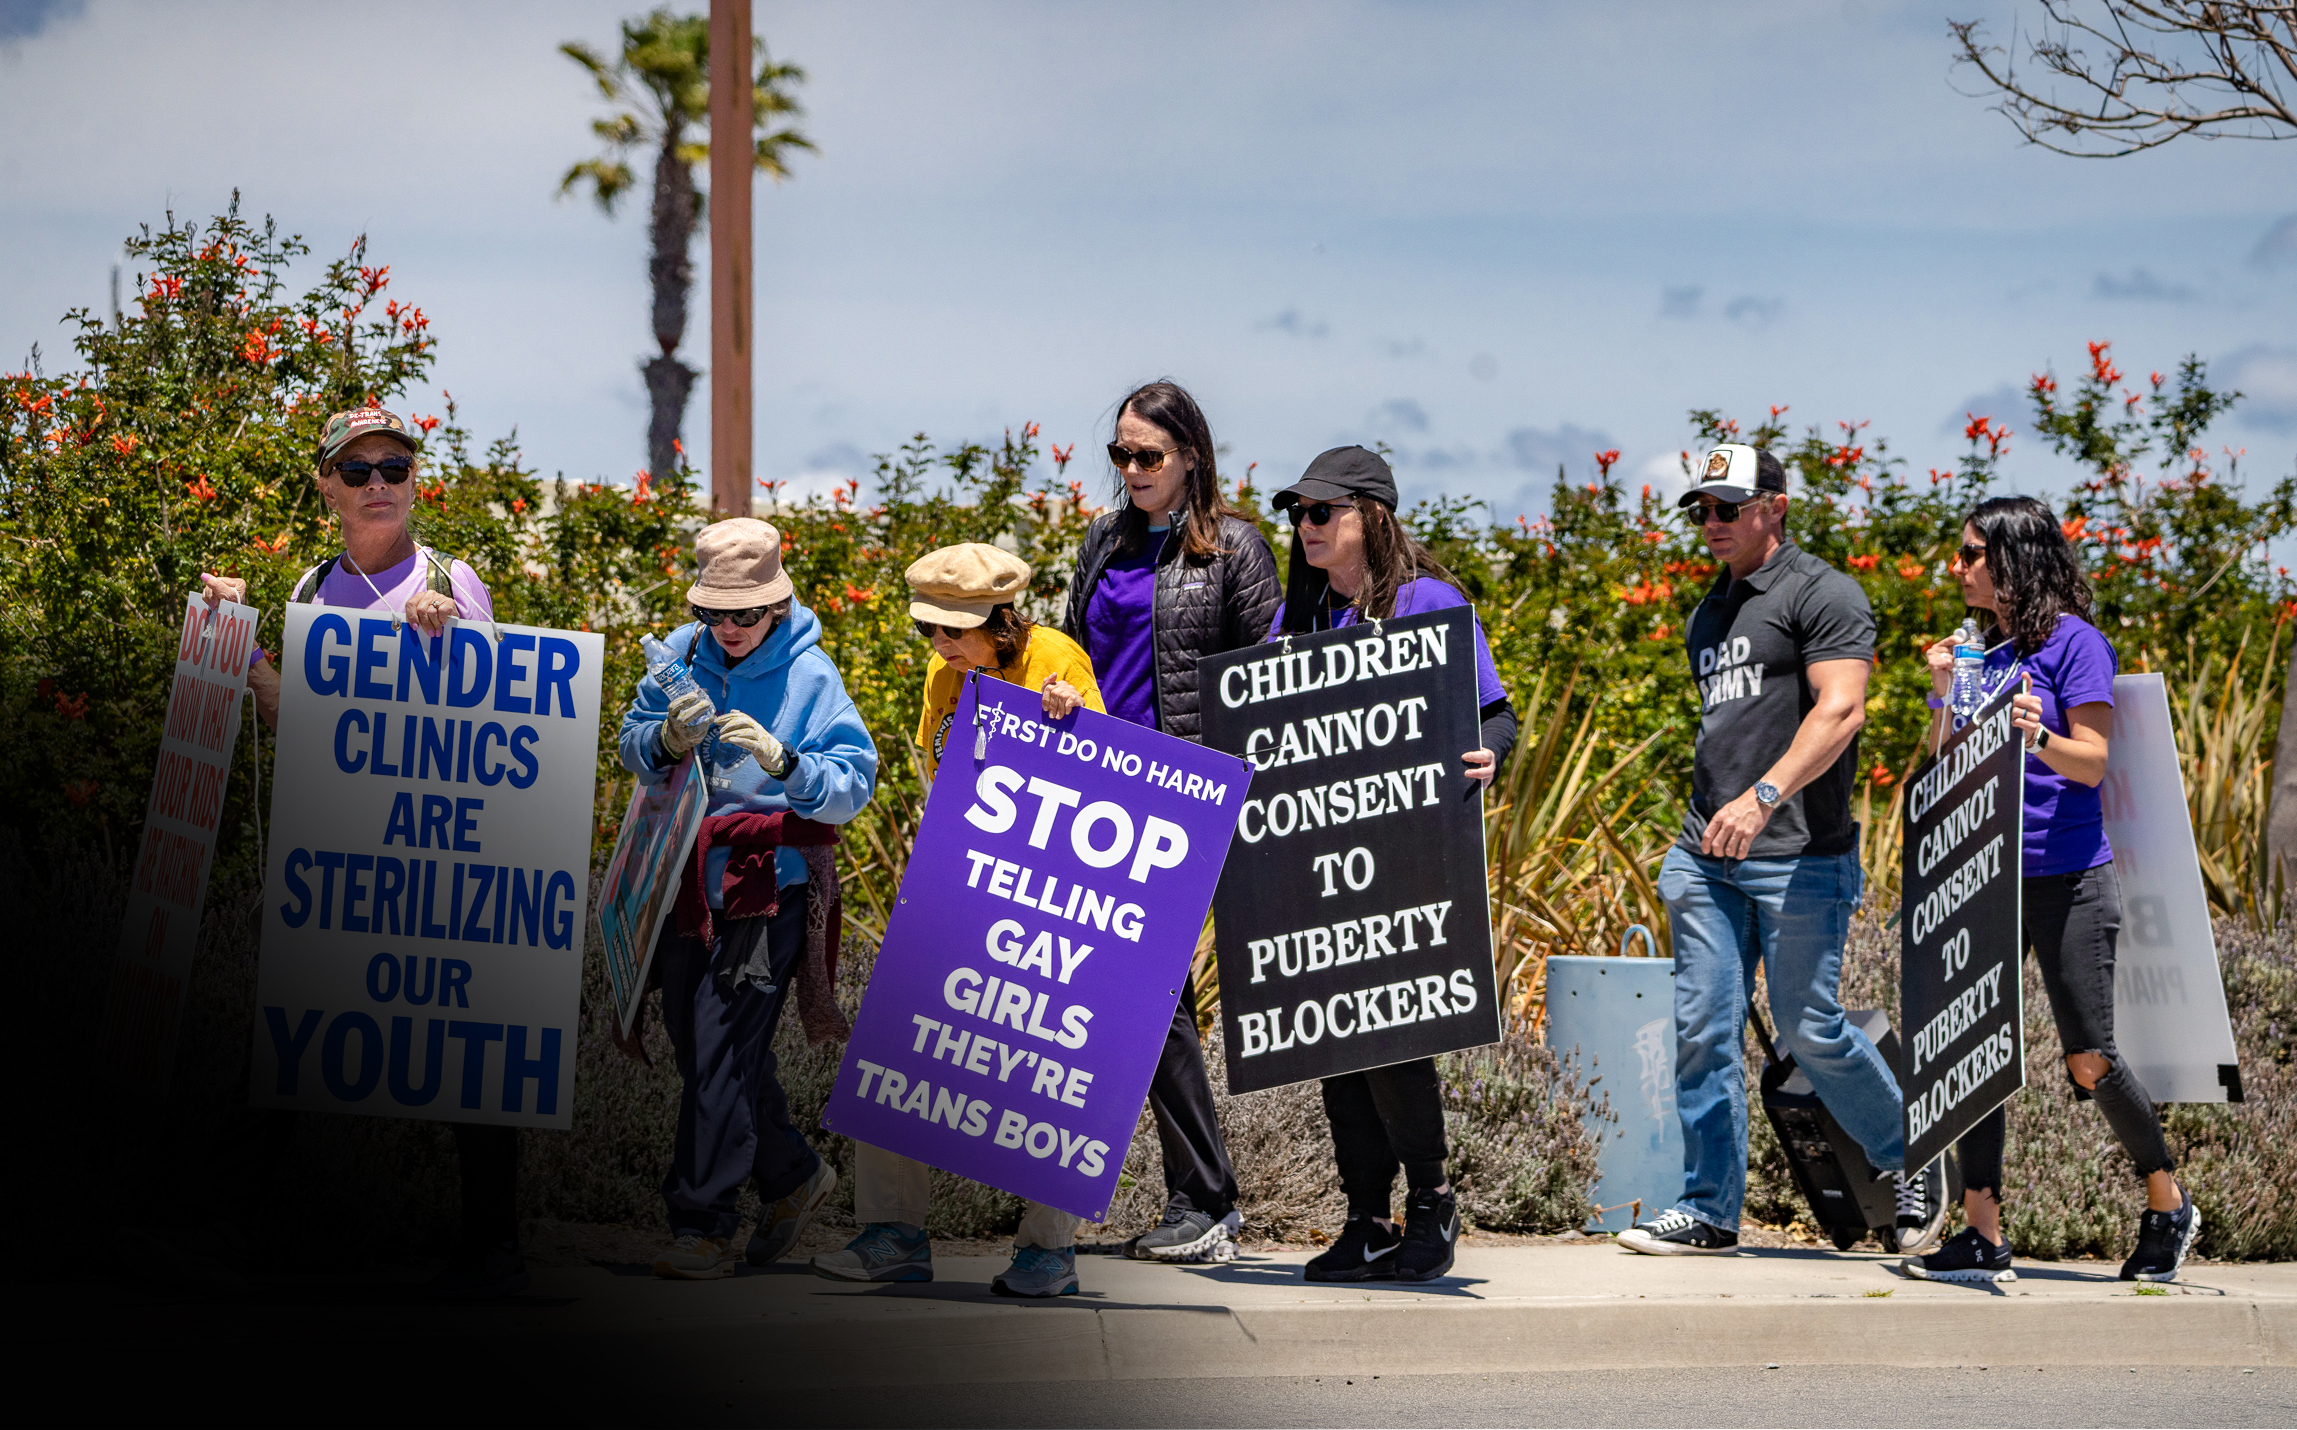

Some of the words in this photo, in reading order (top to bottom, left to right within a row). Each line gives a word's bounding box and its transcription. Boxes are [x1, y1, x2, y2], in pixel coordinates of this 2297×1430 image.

[179, 605, 207, 666] DO
[210, 612, 251, 678] YOU
[304, 612, 580, 718] GENDER
[1220, 624, 1449, 709] CHILDREN
[1699, 637, 1751, 676] DAD
[167, 673, 204, 744] KNOW
[199, 683, 235, 754] WHAT
[333, 708, 540, 789] CLINICS
[703, 727, 721, 764] FEMINIS
[935, 715, 955, 759] FEMINIS
[1246, 696, 1427, 772] CANNOT
[153, 749, 192, 825] YOUR
[187, 761, 225, 833] KIDS
[1056, 730, 1097, 763] DO
[1101, 748, 1142, 779] NO
[1145, 759, 1227, 806] HARM
[1237, 762, 1445, 844] CONSENT
[1910, 701, 2013, 823] CHILDREN
[383, 791, 484, 852] ARE
[964, 764, 1189, 884] STOP
[1918, 776, 1999, 877] CANNOT
[279, 848, 574, 951] STERILIZING
[966, 849, 1145, 943] TELLING
[1313, 847, 1375, 897] TO
[1912, 834, 2004, 945] CONSENT
[365, 952, 472, 1008] OUR
[985, 919, 1094, 985] GAY
[1248, 901, 1452, 984] PUBERTY
[1942, 927, 1970, 983] TO
[943, 968, 1094, 1050] GIRLS
[1238, 968, 1478, 1058] BLOCKERS
[1913, 962, 2003, 1076] PUBERTY
[263, 1006, 563, 1116] YOUTH
[911, 1013, 1094, 1109] THEY'RE
[1908, 1023, 2013, 1146] BLOCKERS
[856, 1058, 993, 1137] TRANS
[994, 1109, 1110, 1178] BOYS
